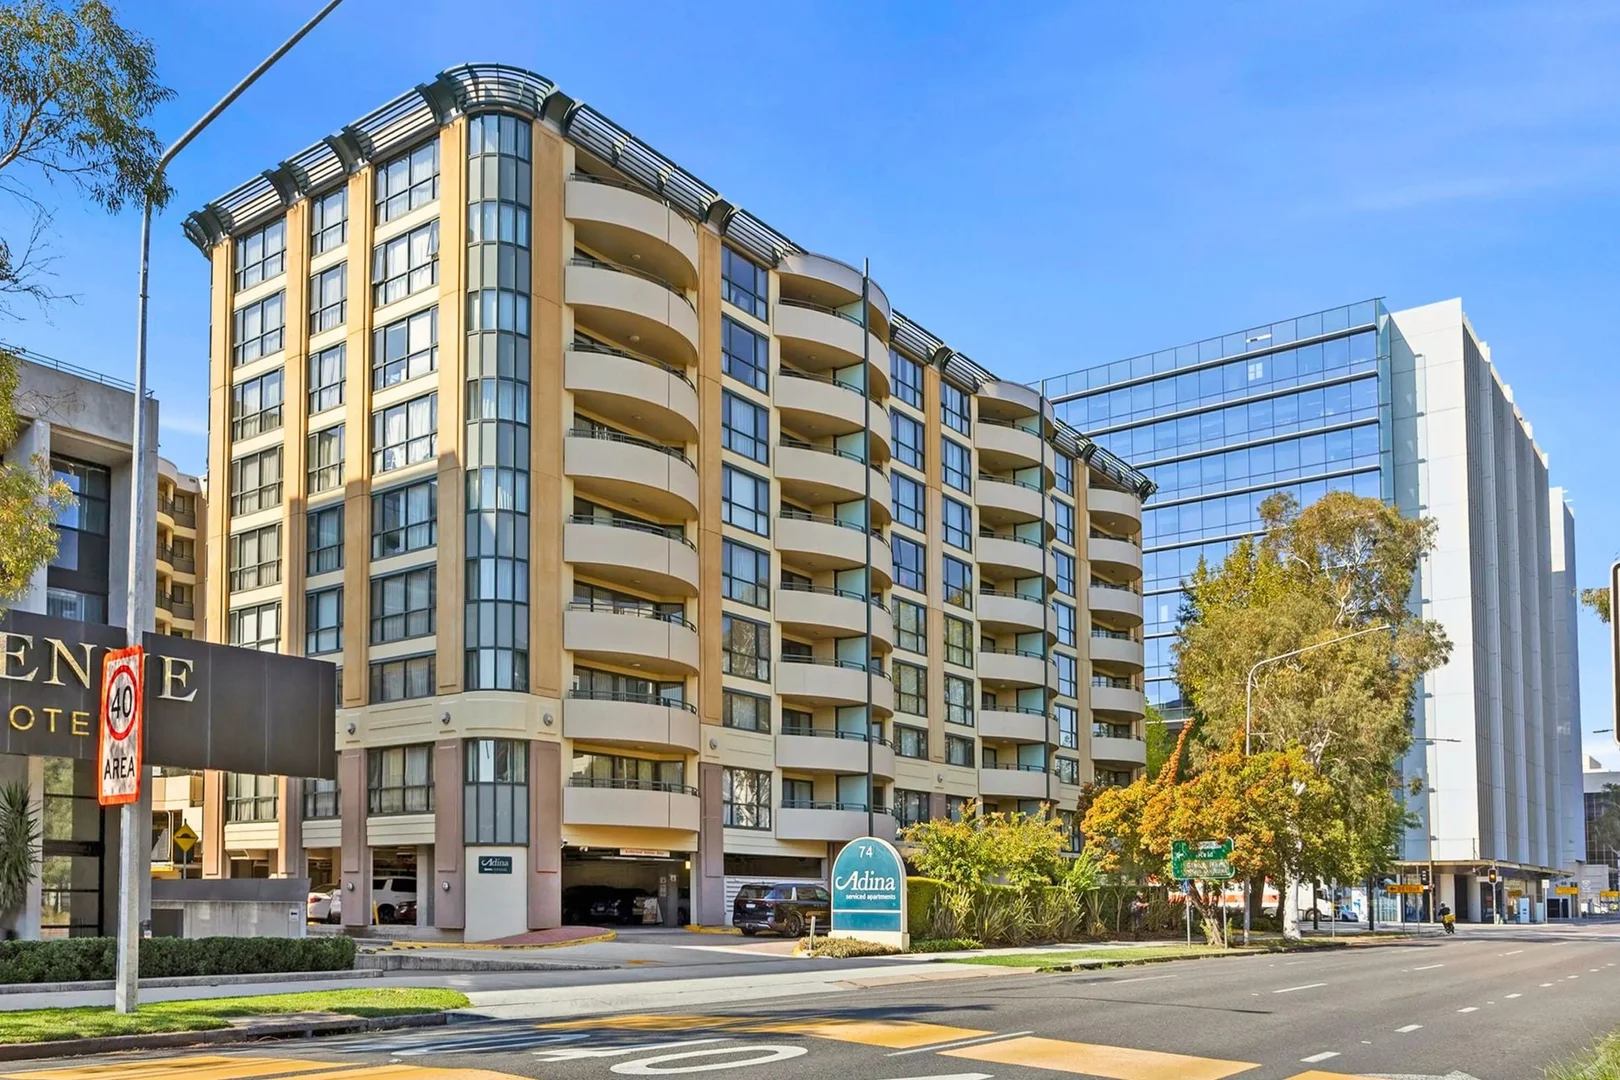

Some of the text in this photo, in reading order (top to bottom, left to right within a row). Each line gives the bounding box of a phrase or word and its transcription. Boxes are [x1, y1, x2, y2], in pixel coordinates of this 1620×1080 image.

[0, 631, 198, 702] ENE
[111, 685, 133, 719] 40
[103, 755, 135, 780] AREA
[858, 845, 874, 858] 74
[481, 858, 509, 867] Adina
[835, 870, 896, 891] Adina
[867, 893, 896, 901] apartments
